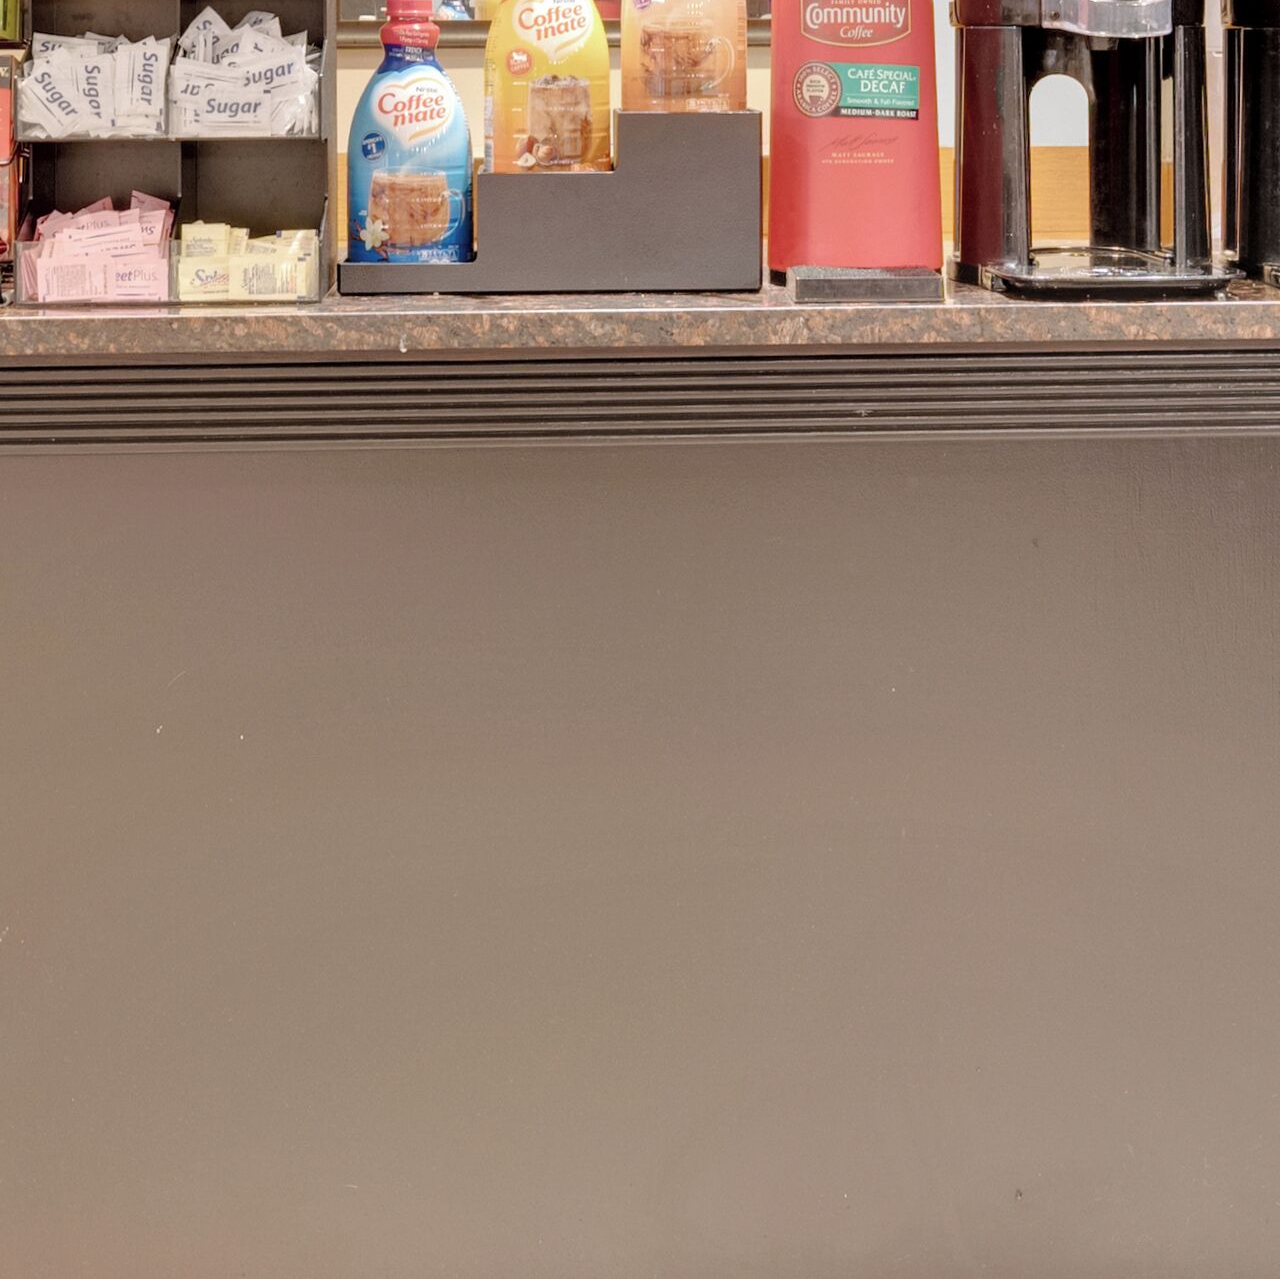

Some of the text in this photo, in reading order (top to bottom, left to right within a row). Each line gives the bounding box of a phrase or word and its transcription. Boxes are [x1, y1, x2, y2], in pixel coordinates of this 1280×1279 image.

[518, 4, 583, 30] Coffee
[805, 2, 906, 29] Community
[535, 16, 587, 42] mate
[840, 25, 874, 40] Coffee
[137, 51, 159, 106] Sugar
[812, 66, 835, 83] SELECT
[848, 68, 874, 79] CAFÉ
[34, 71, 78, 117] Sugar
[82, 64, 102, 119] Sugar
[860, 80, 906, 93] DECAF
[205, 98, 263, 118] Sugar
[377, 92, 444, 115] Coffee
[840, 108, 917, 118] MEDIUM-DARK ROAST
[393, 106, 446, 127] mate
